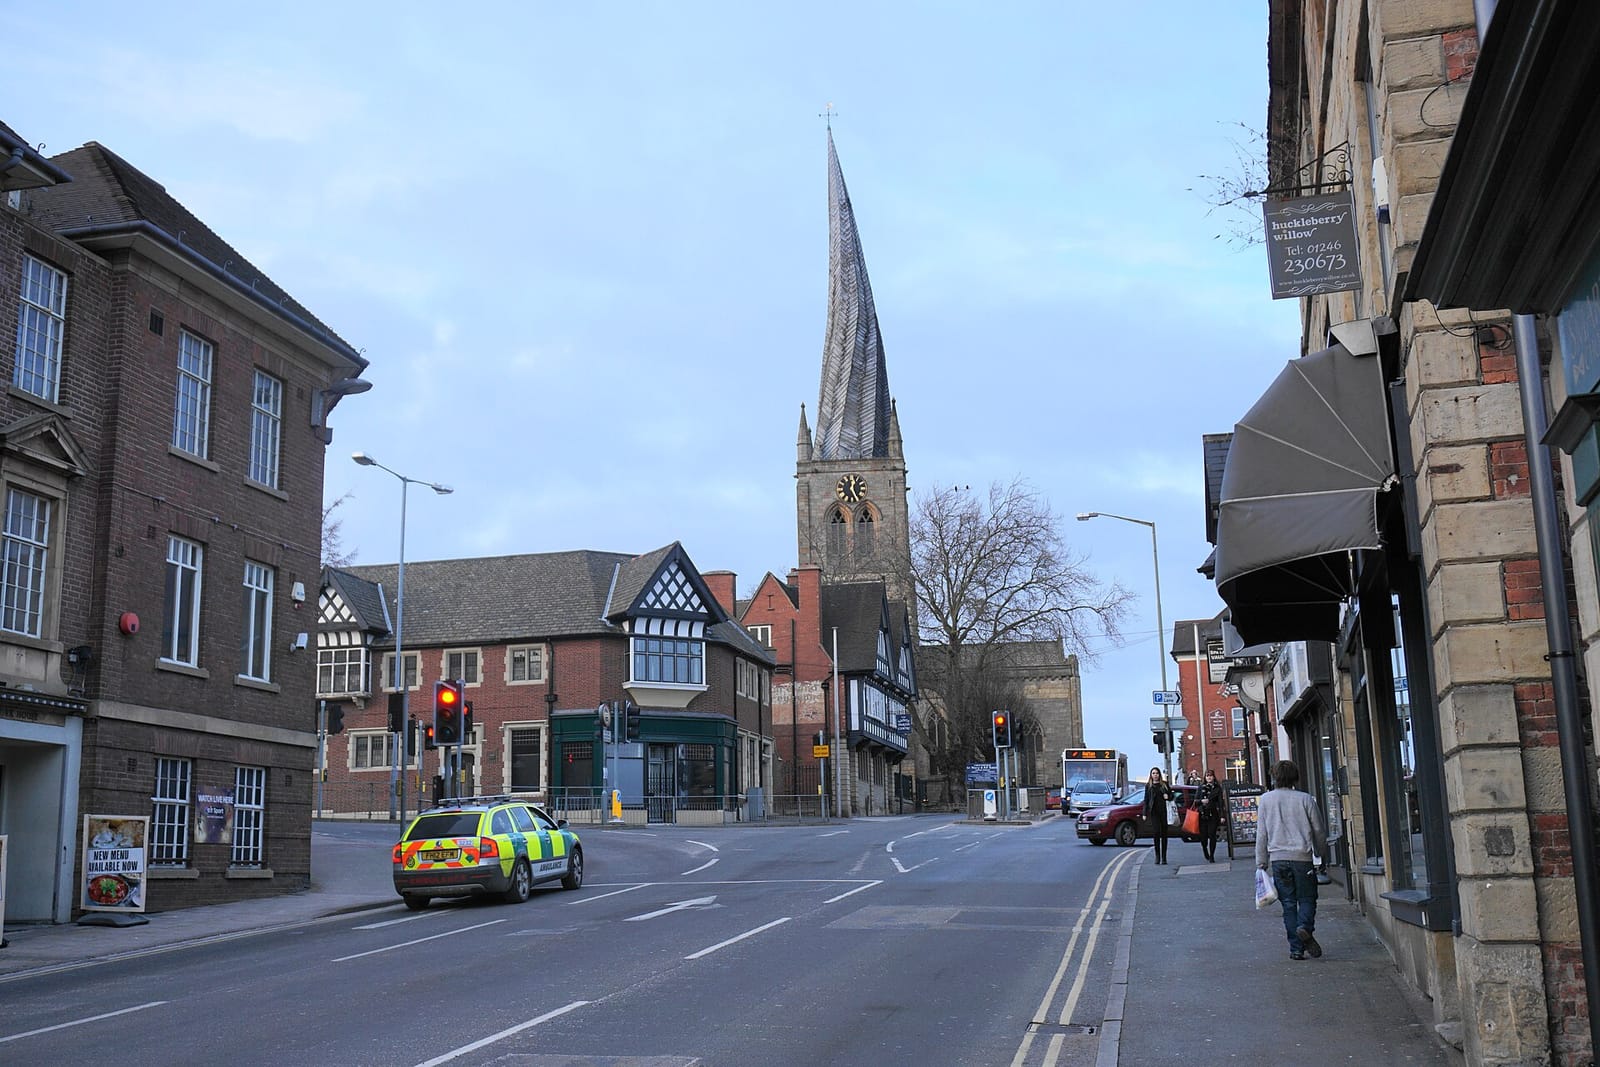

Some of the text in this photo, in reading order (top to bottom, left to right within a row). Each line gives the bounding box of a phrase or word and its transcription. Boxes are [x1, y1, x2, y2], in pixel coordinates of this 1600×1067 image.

[1272, 212, 1347, 230] huckleberry
[1274, 228, 1317, 240] willow
[1287, 240, 1341, 256] Tel: 01246
[1284, 254, 1346, 274] 230673
[198, 794, 212, 802] WATCH
[223, 796, 233, 804] HERE
[94, 850, 129, 860] NEW MENU
[122, 861, 138, 871] NOW
